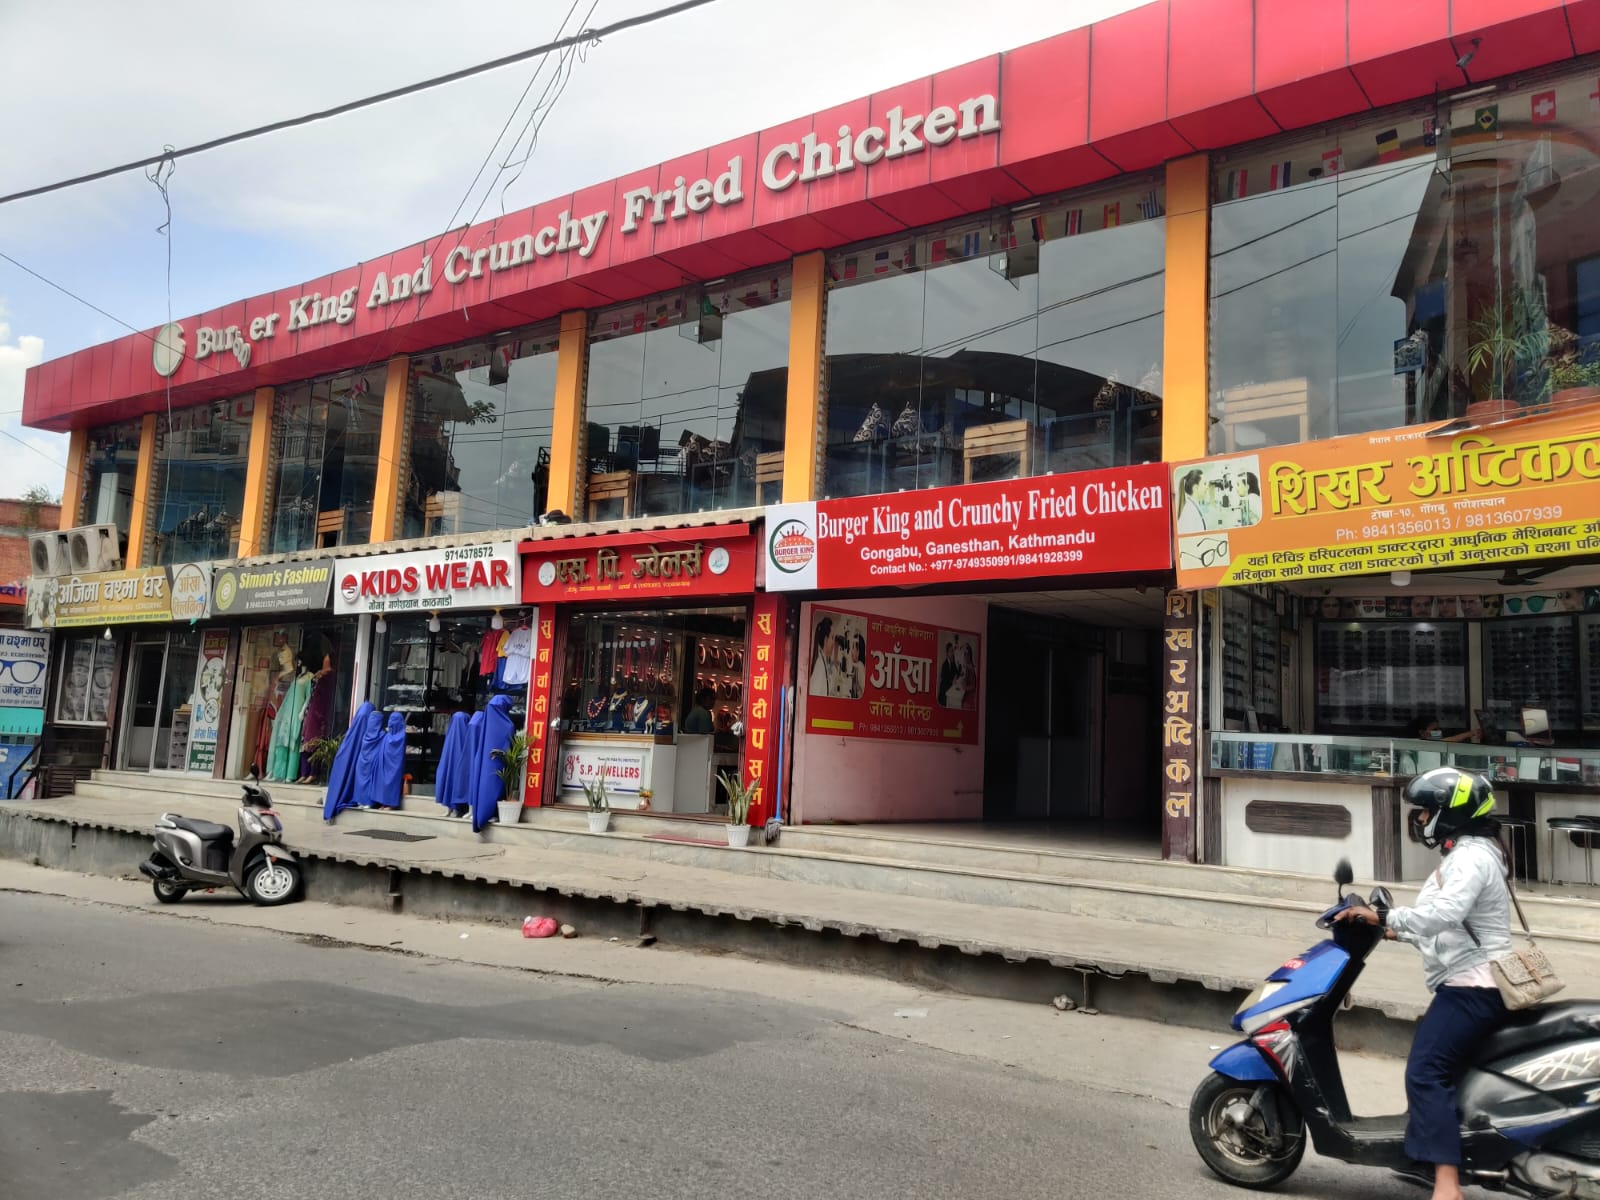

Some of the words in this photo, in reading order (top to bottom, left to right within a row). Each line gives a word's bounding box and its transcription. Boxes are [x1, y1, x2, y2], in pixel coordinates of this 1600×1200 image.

[286, 285, 358, 333] King
[365, 264, 434, 309] And
[443, 206, 609, 285] Crunchy
[621, 155, 743, 234] Fried
[760, 93, 1001, 191] Chicken
[1268, 458, 1394, 516] शिखर
[818, 511, 869, 544] Burger
[872, 505, 911, 539] King
[914, 501, 944, 532] and
[947, 493, 1023, 531] Crunchy
[1027, 486, 1079, 520] Fried
[1082, 478, 1163, 515] Chicken
[1336, 528, 1358, 541] Ph:
[1362, 517, 1451, 540] 9841356013
[1456, 515, 1462, 529] /
[1465, 505, 1563, 528] 9813607939
[445, 546, 494, 560] 9714378572
[631, 543, 705, 579] ज्वेलर्स
[860, 542, 921, 561] Gongabu,
[925, 537, 1003, 557] Ganesthan,
[1008, 529, 1095, 550] Kathmandu
[1232, 568, 1275, 582] गरिनुका
[1280, 563, 1303, 577] साथै
[1308, 563, 1335, 574] पावर
[1339, 560, 1363, 571] तथा
[1367, 552, 1424, 568] डाक्टरको
[1460, 542, 1529, 562] अनुसारको
[1534, 540, 1570, 555] चश्मा
[1273, 550, 1305, 564] टिचिङ
[1309, 545, 1373, 562] हस्पिटलका
[1378, 538, 1445, 554] डाक्टरद्वारा
[1450, 531, 1509, 547] आधुनिक
[1512, 523, 1577, 542] मेशिनबाट
[240, 569, 281, 589] Simon's
[282, 566, 329, 586] Fashion
[361, 566, 420, 597] KIDS
[425, 559, 511, 591] WEAR
[870, 562, 906, 576] Contact
[908, 561, 928, 574] No.:
[930, 550, 1083, 572] +977-9749350991/9841928399
[58, 577, 101, 605] अजिमा
[104, 577, 140, 602] चश्मा
[142, 573, 167, 599] घर
[6, 634, 32, 649] चश्मा
[870, 641, 934, 694] आँखा
[868, 696, 894, 718] जाँच
[898, 699, 934, 721] गरिन्छ
[579, 764, 593, 775] S.P.
